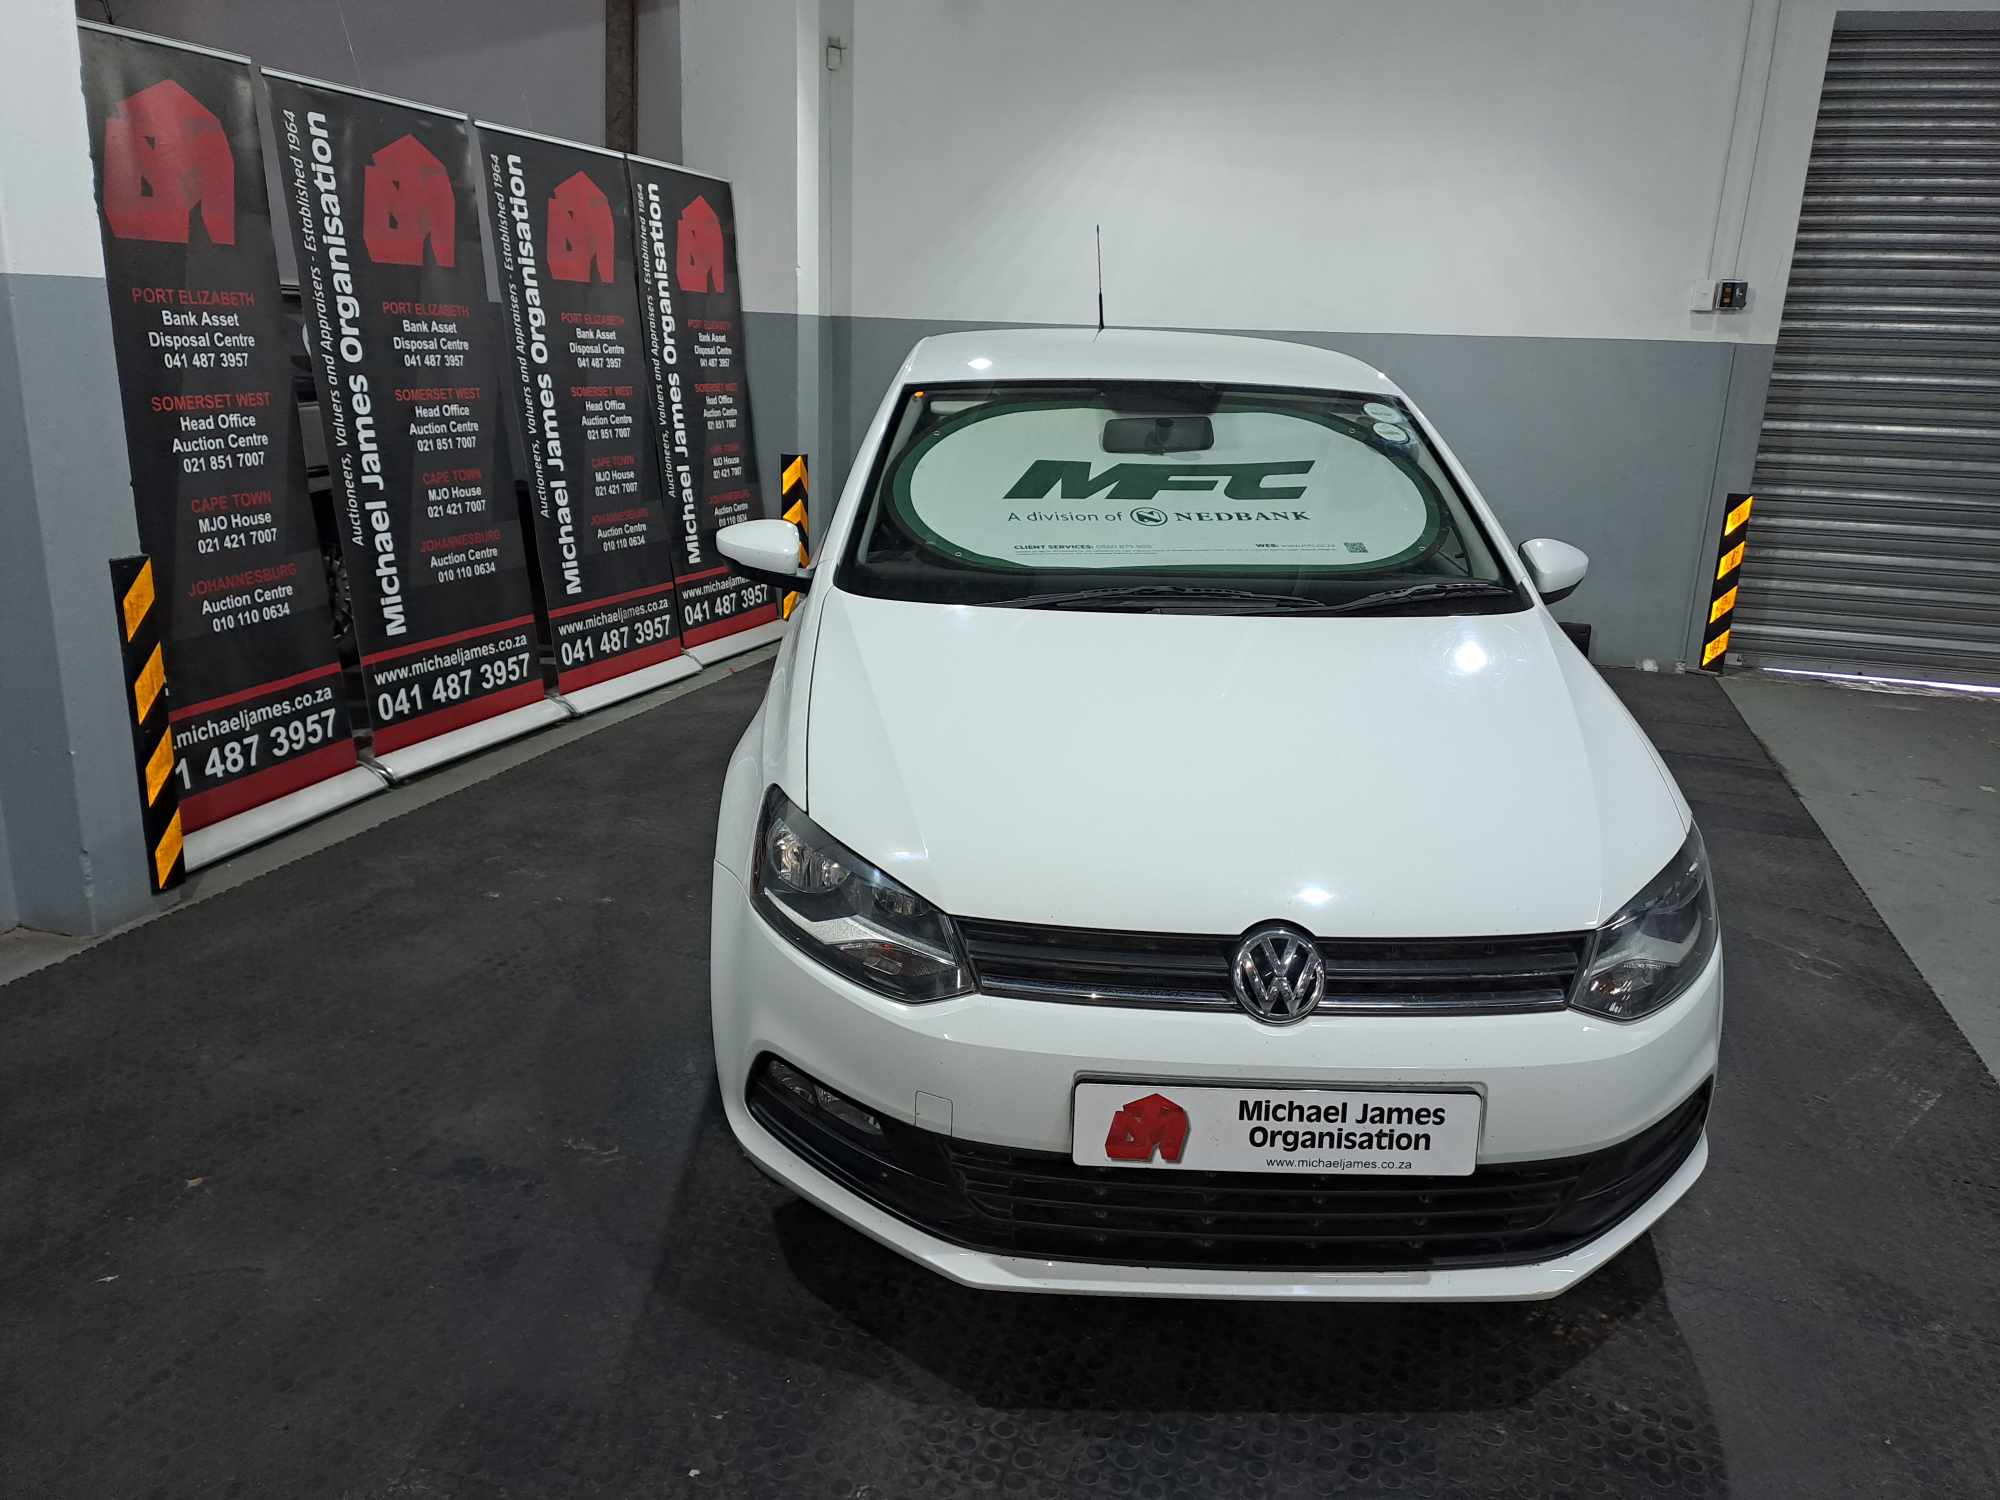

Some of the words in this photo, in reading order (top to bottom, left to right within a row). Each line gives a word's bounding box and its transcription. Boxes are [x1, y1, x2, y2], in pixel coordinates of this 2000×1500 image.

[283, 109, 300, 152] 1964
[490, 154, 504, 190] 1964
[294, 156, 316, 252] Established
[636, 183, 645, 214] 1964
[308, 111, 363, 364] Organisation
[497, 192, 514, 271] Established
[507, 154, 548, 364] Organisation
[638, 215, 652, 285] Established
[648, 183, 677, 365] Organisation
[132, 288, 174, 304] PORT
[178, 290, 256, 307] ELIZABETH
[310, 266, 332, 352] Appraisers
[162, 310, 198, 326] Bank
[201, 312, 240, 326] Asset
[402, 320, 429, 332] Bank
[431, 321, 458, 333] Asset
[509, 284, 526, 354] Appraisers
[646, 294, 660, 357] Appraisers
[148, 332, 210, 350] Disposal
[214, 332, 256, 347] Centre
[393, 336, 438, 352] Disposal
[440, 338, 470, 350] Centre
[570, 342, 600, 355] Disposal
[596, 329, 616, 340] Asset
[164, 354, 188, 368] 041
[192, 353, 214, 368] 487
[220, 352, 248, 367] 3957
[322, 354, 338, 386] and
[404, 355, 421, 367] 041
[424, 355, 441, 367] 487
[444, 354, 464, 366] 3957
[516, 355, 530, 382] and
[652, 359, 662, 381] and
[151, 394, 231, 412] SOMERSET
[236, 392, 272, 408] WEST
[415, 406, 440, 418] Head
[442, 404, 470, 416] Office
[524, 385, 538, 434] Valuers
[586, 401, 602, 412] Head
[604, 400, 626, 410] Office
[656, 384, 667, 426] Valuers
[668, 372, 688, 458] James
[180, 416, 214, 432] Head
[218, 414, 256, 428] Office
[330, 388, 348, 448] Valuers
[349, 374, 384, 490] James
[410, 422, 447, 436] Auction
[450, 420, 479, 433] Centre
[537, 374, 565, 472] James
[582, 415, 608, 426] Auction
[610, 414, 632, 424] Centre
[172, 436, 224, 453] Auction
[228, 433, 269, 448] Centre
[417, 439, 433, 452] 021
[436, 438, 453, 451] 851
[456, 436, 476, 449] 7007
[184, 458, 206, 473] 021
[210, 454, 232, 470] 851
[237, 452, 265, 468] 7007
[612, 470, 634, 480] House
[662, 430, 676, 498] Auctioneers,
[428, 488, 450, 502] MJO
[452, 486, 482, 498] House
[531, 440, 550, 519] Auctioneers,
[1002, 460, 1316, 500] MFC
[192, 496, 229, 512] CAPE
[232, 490, 272, 506] TOWN
[342, 452, 364, 546] Auctioneers,
[428, 506, 444, 518] 021
[447, 504, 463, 515] 421
[466, 500, 486, 513] 7007
[199, 516, 227, 534] MJO
[231, 512, 272, 528] House
[677, 466, 700, 564] Michael
[1008, 511, 1022, 522] A
[1027, 510, 1100, 522] division
[1106, 510, 1124, 522] of
[1174, 510, 1312, 522] NEDBANK
[198, 538, 220, 554] 021
[224, 534, 246, 550] 421
[250, 528, 278, 544] 7007
[550, 480, 582, 595] Michael
[597, 526, 623, 540] Auction
[624, 522, 647, 534] Centre
[366, 500, 407, 636] Michael
[431, 552, 466, 568] Auction
[468, 548, 498, 560] Centre
[438, 572, 454, 583] 010
[456, 566, 472, 579] 110
[474, 562, 496, 576] 0634
[188, 563, 296, 597] JOHANNESBURG
[682, 576, 751, 600] www.michaeljam
[202, 594, 250, 615] Auction
[254, 584, 294, 603] Centre
[684, 600, 710, 626] 041
[715, 592, 737, 616] 487
[741, 584, 768, 608] 3957
[212, 617, 234, 632] 010
[238, 610, 259, 626] 110
[263, 602, 290, 620] 0634
[558, 598, 668, 636] www.michaeljames.co.za
[560, 636, 594, 666] 041
[600, 626, 629, 654] 487
[634, 614, 670, 644] 3957
[374, 634, 528, 686] www.michaeljames.co.za
[378, 684, 424, 720] 041
[432, 669, 472, 703] 487
[480, 652, 530, 690] 3957
[205, 734, 260, 778] 487
[270, 708, 336, 757] 3957
[1238, 1099, 1348, 1125] Michael
[1356, 1103, 1446, 1126] James
[1249, 1126, 1432, 1152] Organisation
[1266, 1158, 1412, 1171] www.michaeljames.co.za
